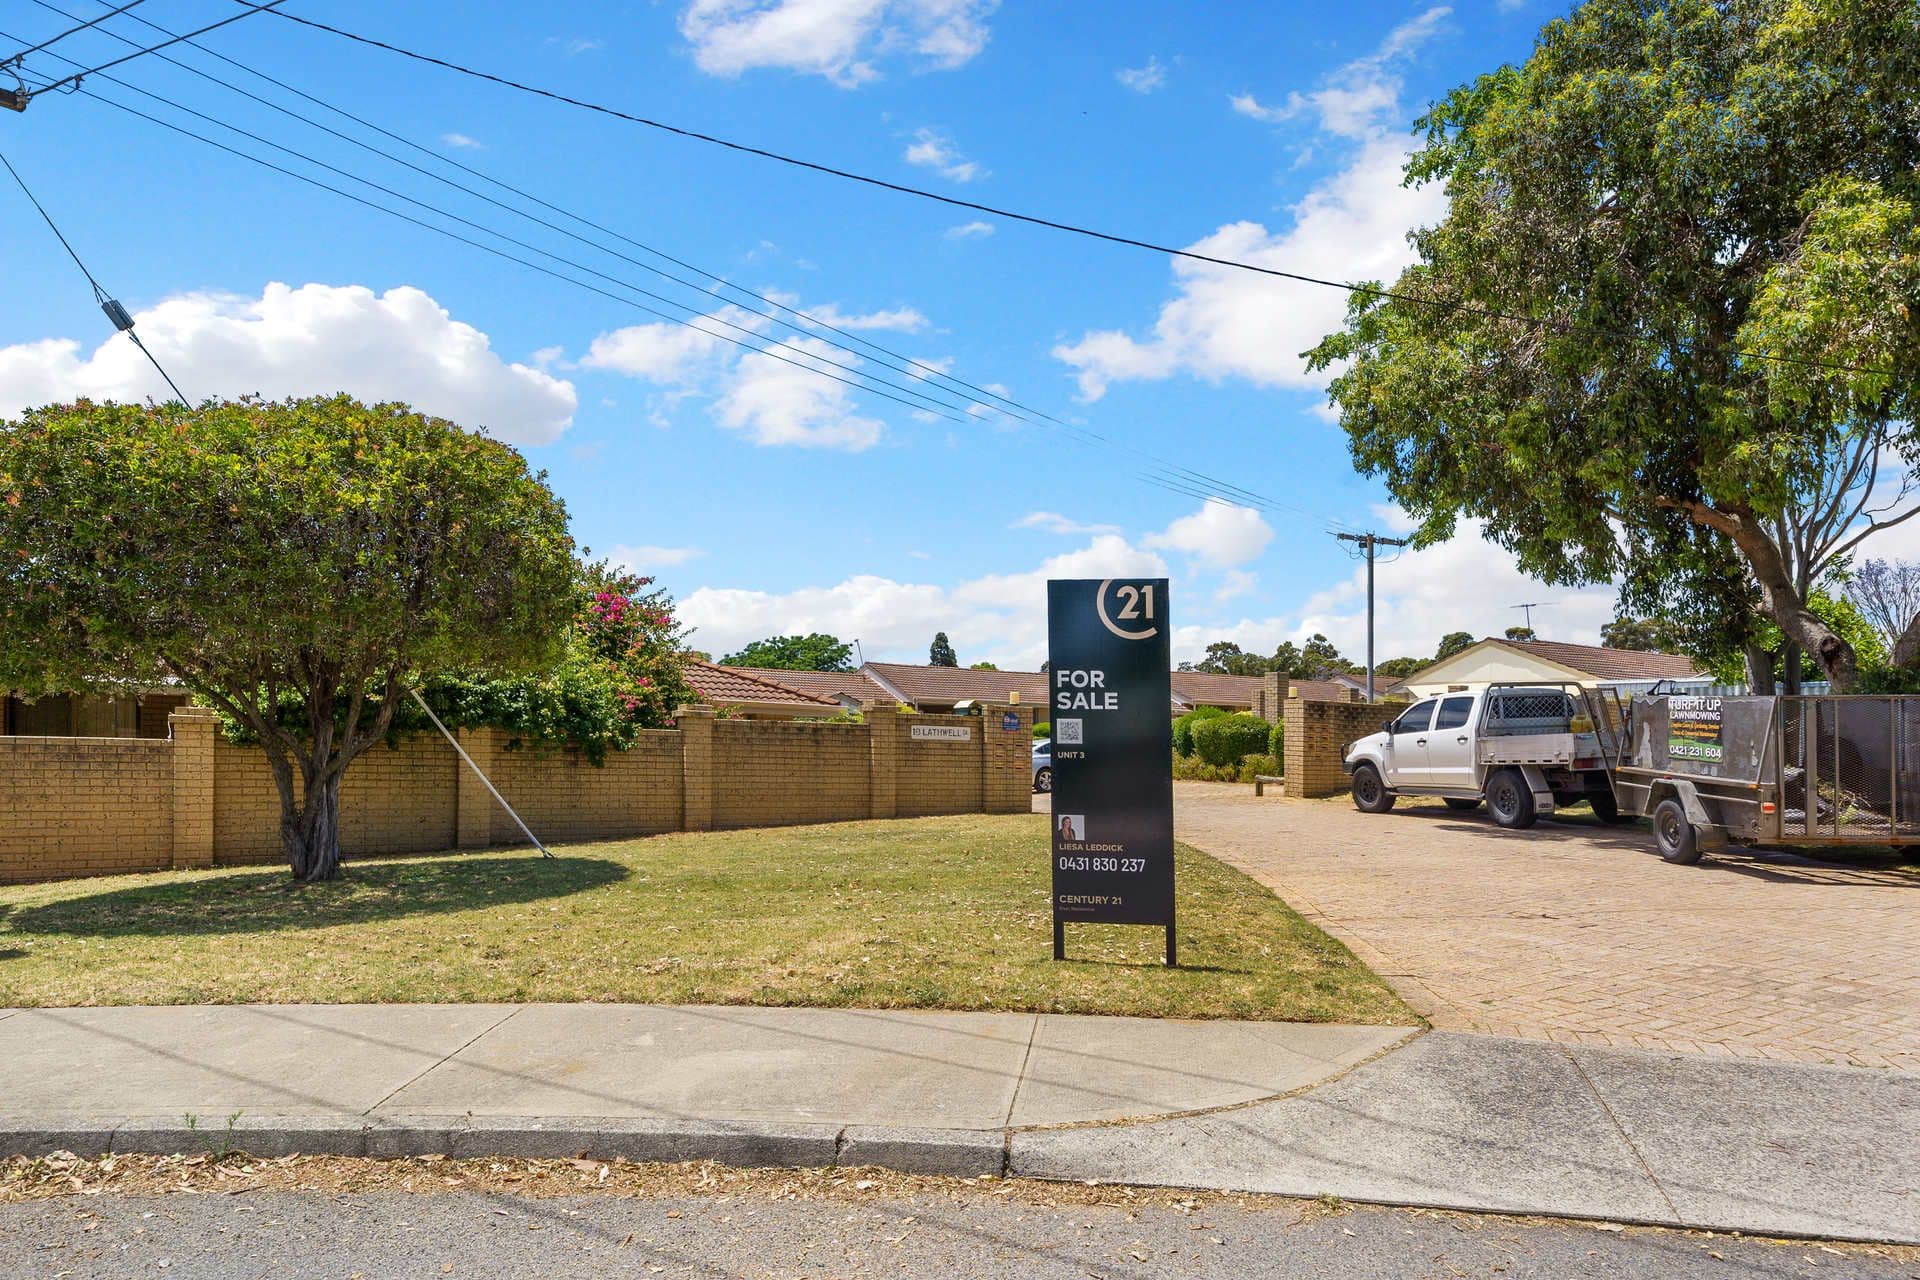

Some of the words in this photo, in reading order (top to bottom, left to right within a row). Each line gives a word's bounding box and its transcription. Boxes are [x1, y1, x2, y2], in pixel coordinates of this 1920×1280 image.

[1116, 585, 1154, 620] 21
[1057, 670, 1105, 688] FOR
[1057, 692, 1119, 710] SALE
[1669, 699, 1694, 710] TURF
[1696, 699, 1705, 710] IT
[1706, 699, 1721, 711] UP
[1669, 710, 1721, 721] LAWNMOWING
[922, 727, 961, 737] LATHWELL
[1057, 751, 1079, 759] UNIT
[1669, 745, 1687, 755] 0421
[1687, 746, 1703, 756] 231
[1705, 748, 1721, 758] 604
[1059, 843, 1084, 851] LIESA
[1059, 857, 1089, 871] 0431
[1093, 857, 1118, 872] 830
[1121, 858, 1146, 873] 237
[1059, 895, 1109, 905] CENTURY
[1111, 896, 1122, 905] 21
